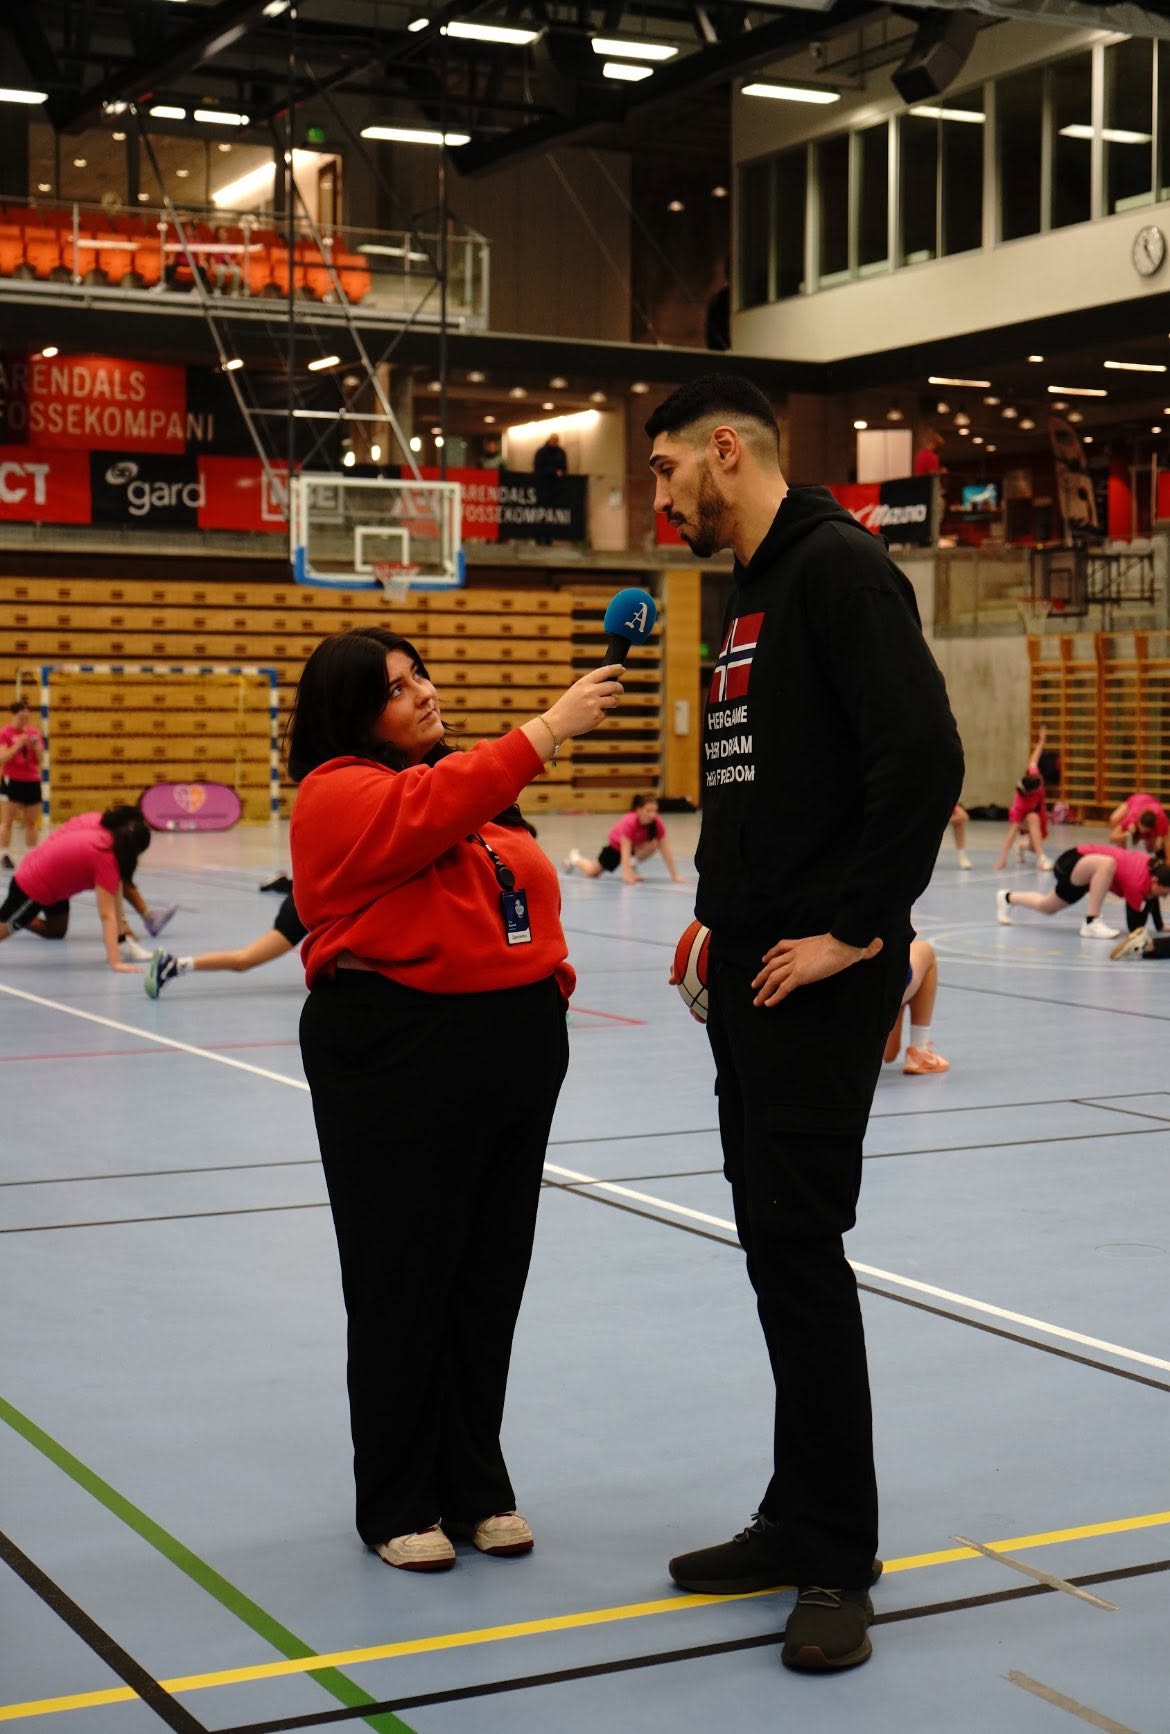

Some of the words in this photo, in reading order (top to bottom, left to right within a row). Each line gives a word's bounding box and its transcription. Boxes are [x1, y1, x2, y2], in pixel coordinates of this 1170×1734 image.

[127, 472, 206, 516] gard
[624, 602, 648, 633] A
[708, 711, 723, 730] HER
[724, 705, 748, 728] GAME
[720, 735, 753, 758] DRAM
[716, 764, 755, 786] FREDOM
